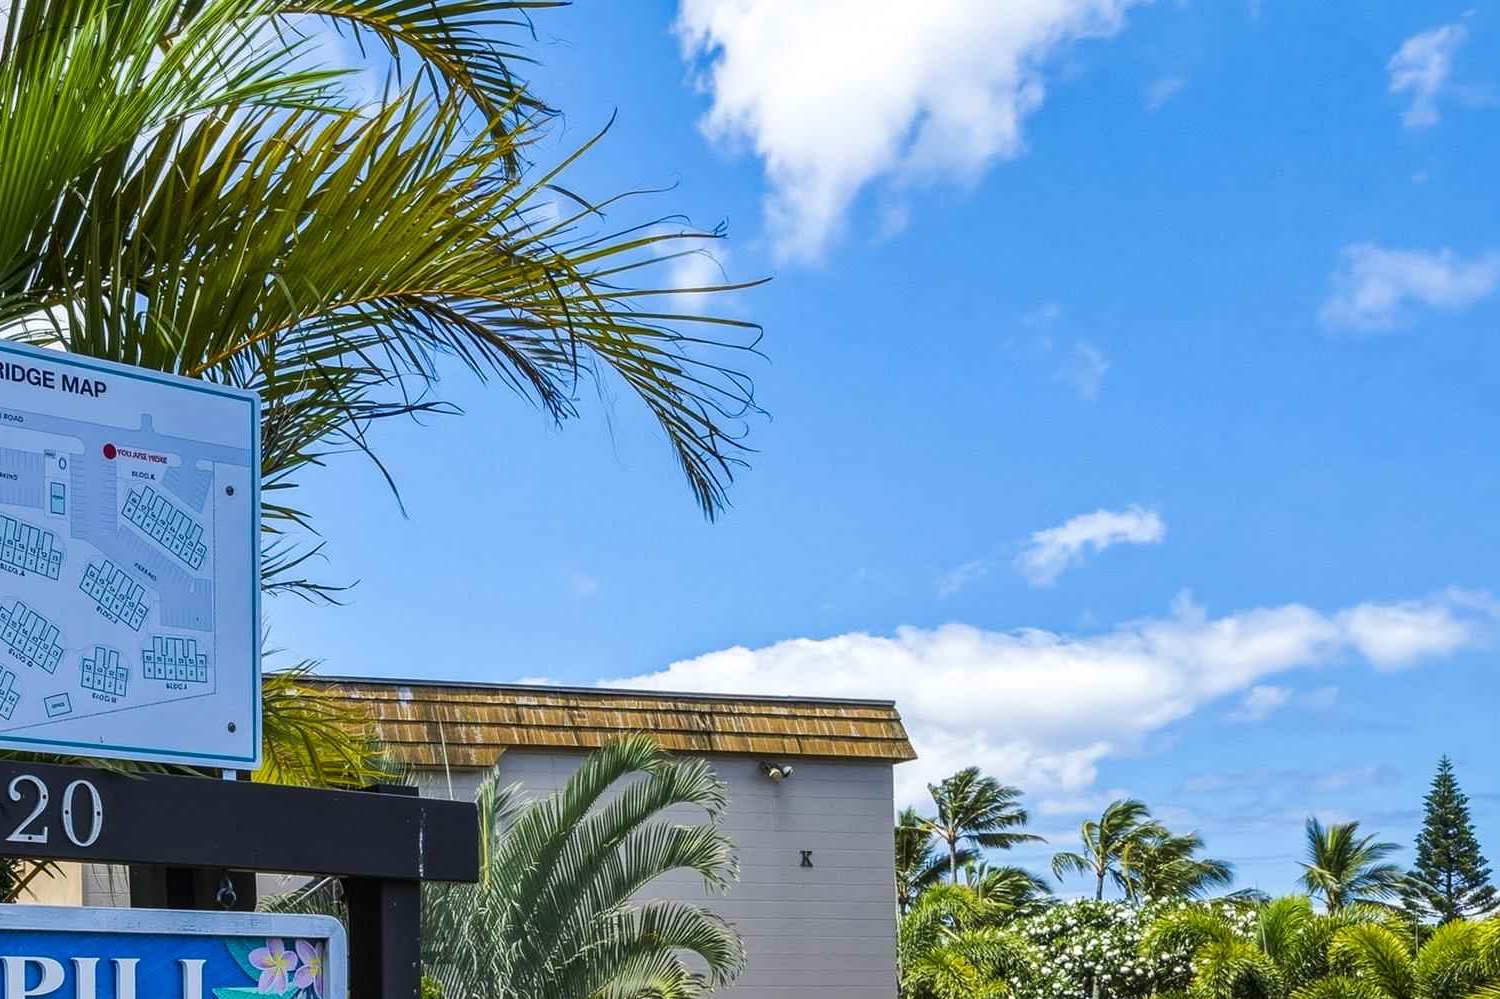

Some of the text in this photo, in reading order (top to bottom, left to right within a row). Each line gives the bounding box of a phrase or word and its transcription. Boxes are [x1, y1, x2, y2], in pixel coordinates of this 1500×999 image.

[61, 374, 107, 398] MAP
[3, 413, 24, 423] ROAD
[116, 449, 132, 458] YOU
[132, 452, 148, 461] ARE
[799, 850, 813, 867] K
